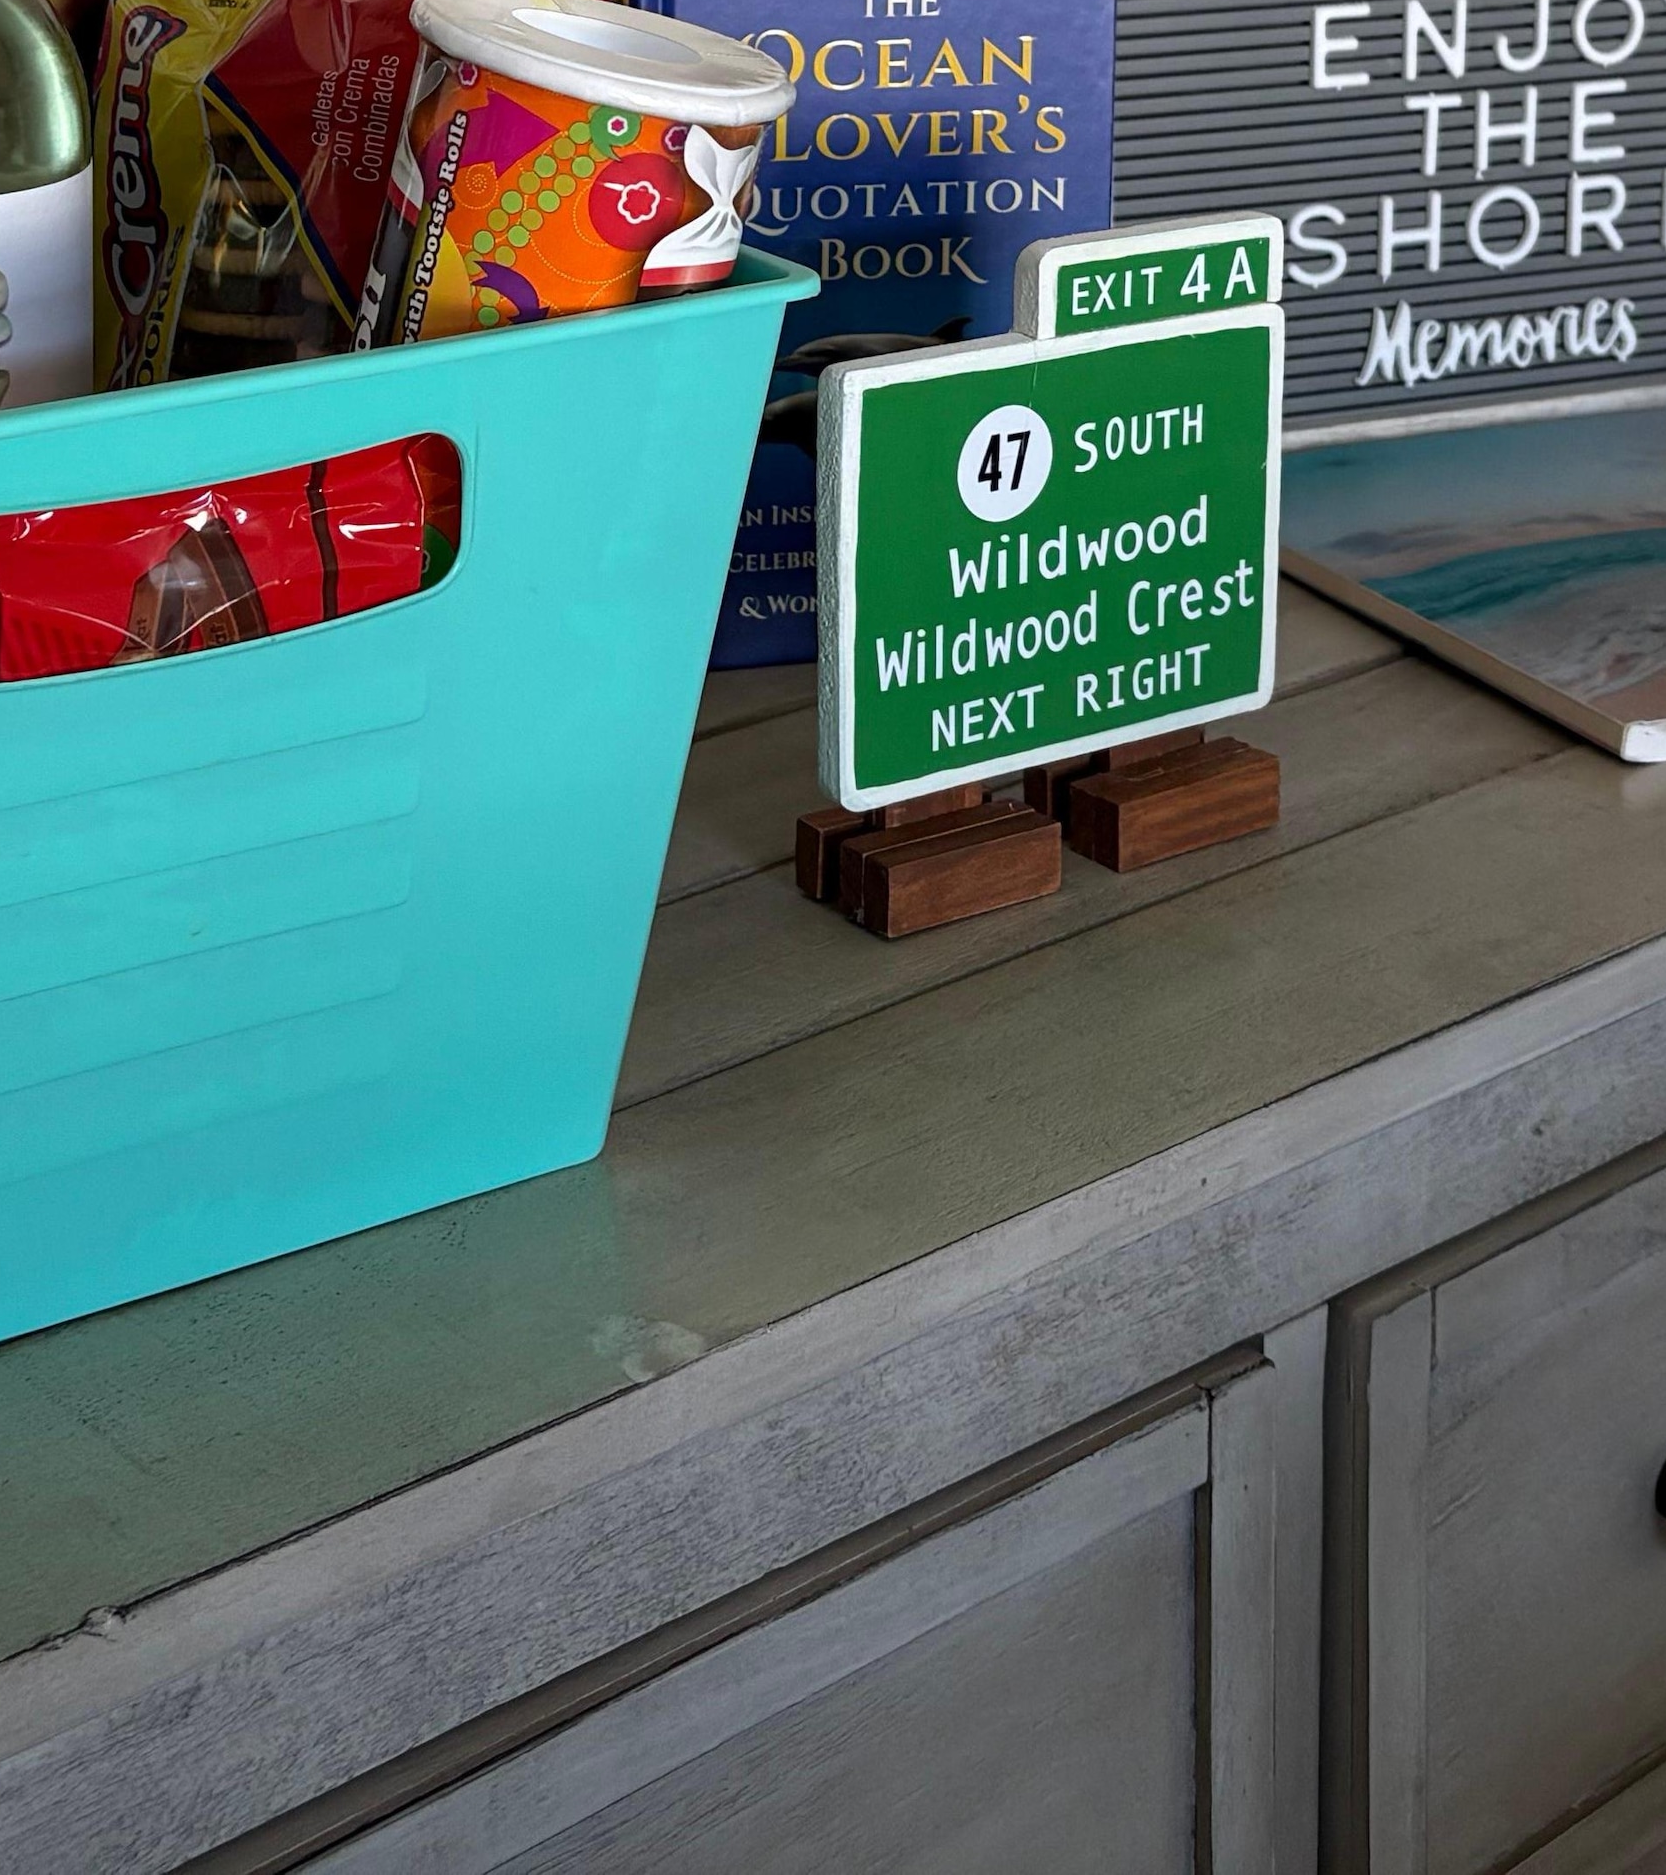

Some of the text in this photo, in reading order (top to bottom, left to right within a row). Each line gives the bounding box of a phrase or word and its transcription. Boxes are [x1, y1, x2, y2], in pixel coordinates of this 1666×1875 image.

[312, 70, 340, 148] Galletas
[334, 57, 372, 124] Crema
[352, 54, 401, 183] Combinadas
[770, 95, 1067, 162] LOVER'S
[1404, 79, 1628, 180] THE
[113, 13, 165, 317] Creme
[414, 188, 451, 285] Tootsie
[437, 111, 469, 184] Rolls
[820, 236, 988, 285] BOOK
[1071, 265, 1163, 316] EXIT
[1354, 296, 1638, 388] Memories
[976, 403, 1204, 493] 47 SOUTH
[948, 494, 1209, 599] Wildwood
[738, 595, 768, 620] &
[875, 558, 1255, 693] Wildwood Crest
[931, 643, 1211, 752] NEXT RIGHT
